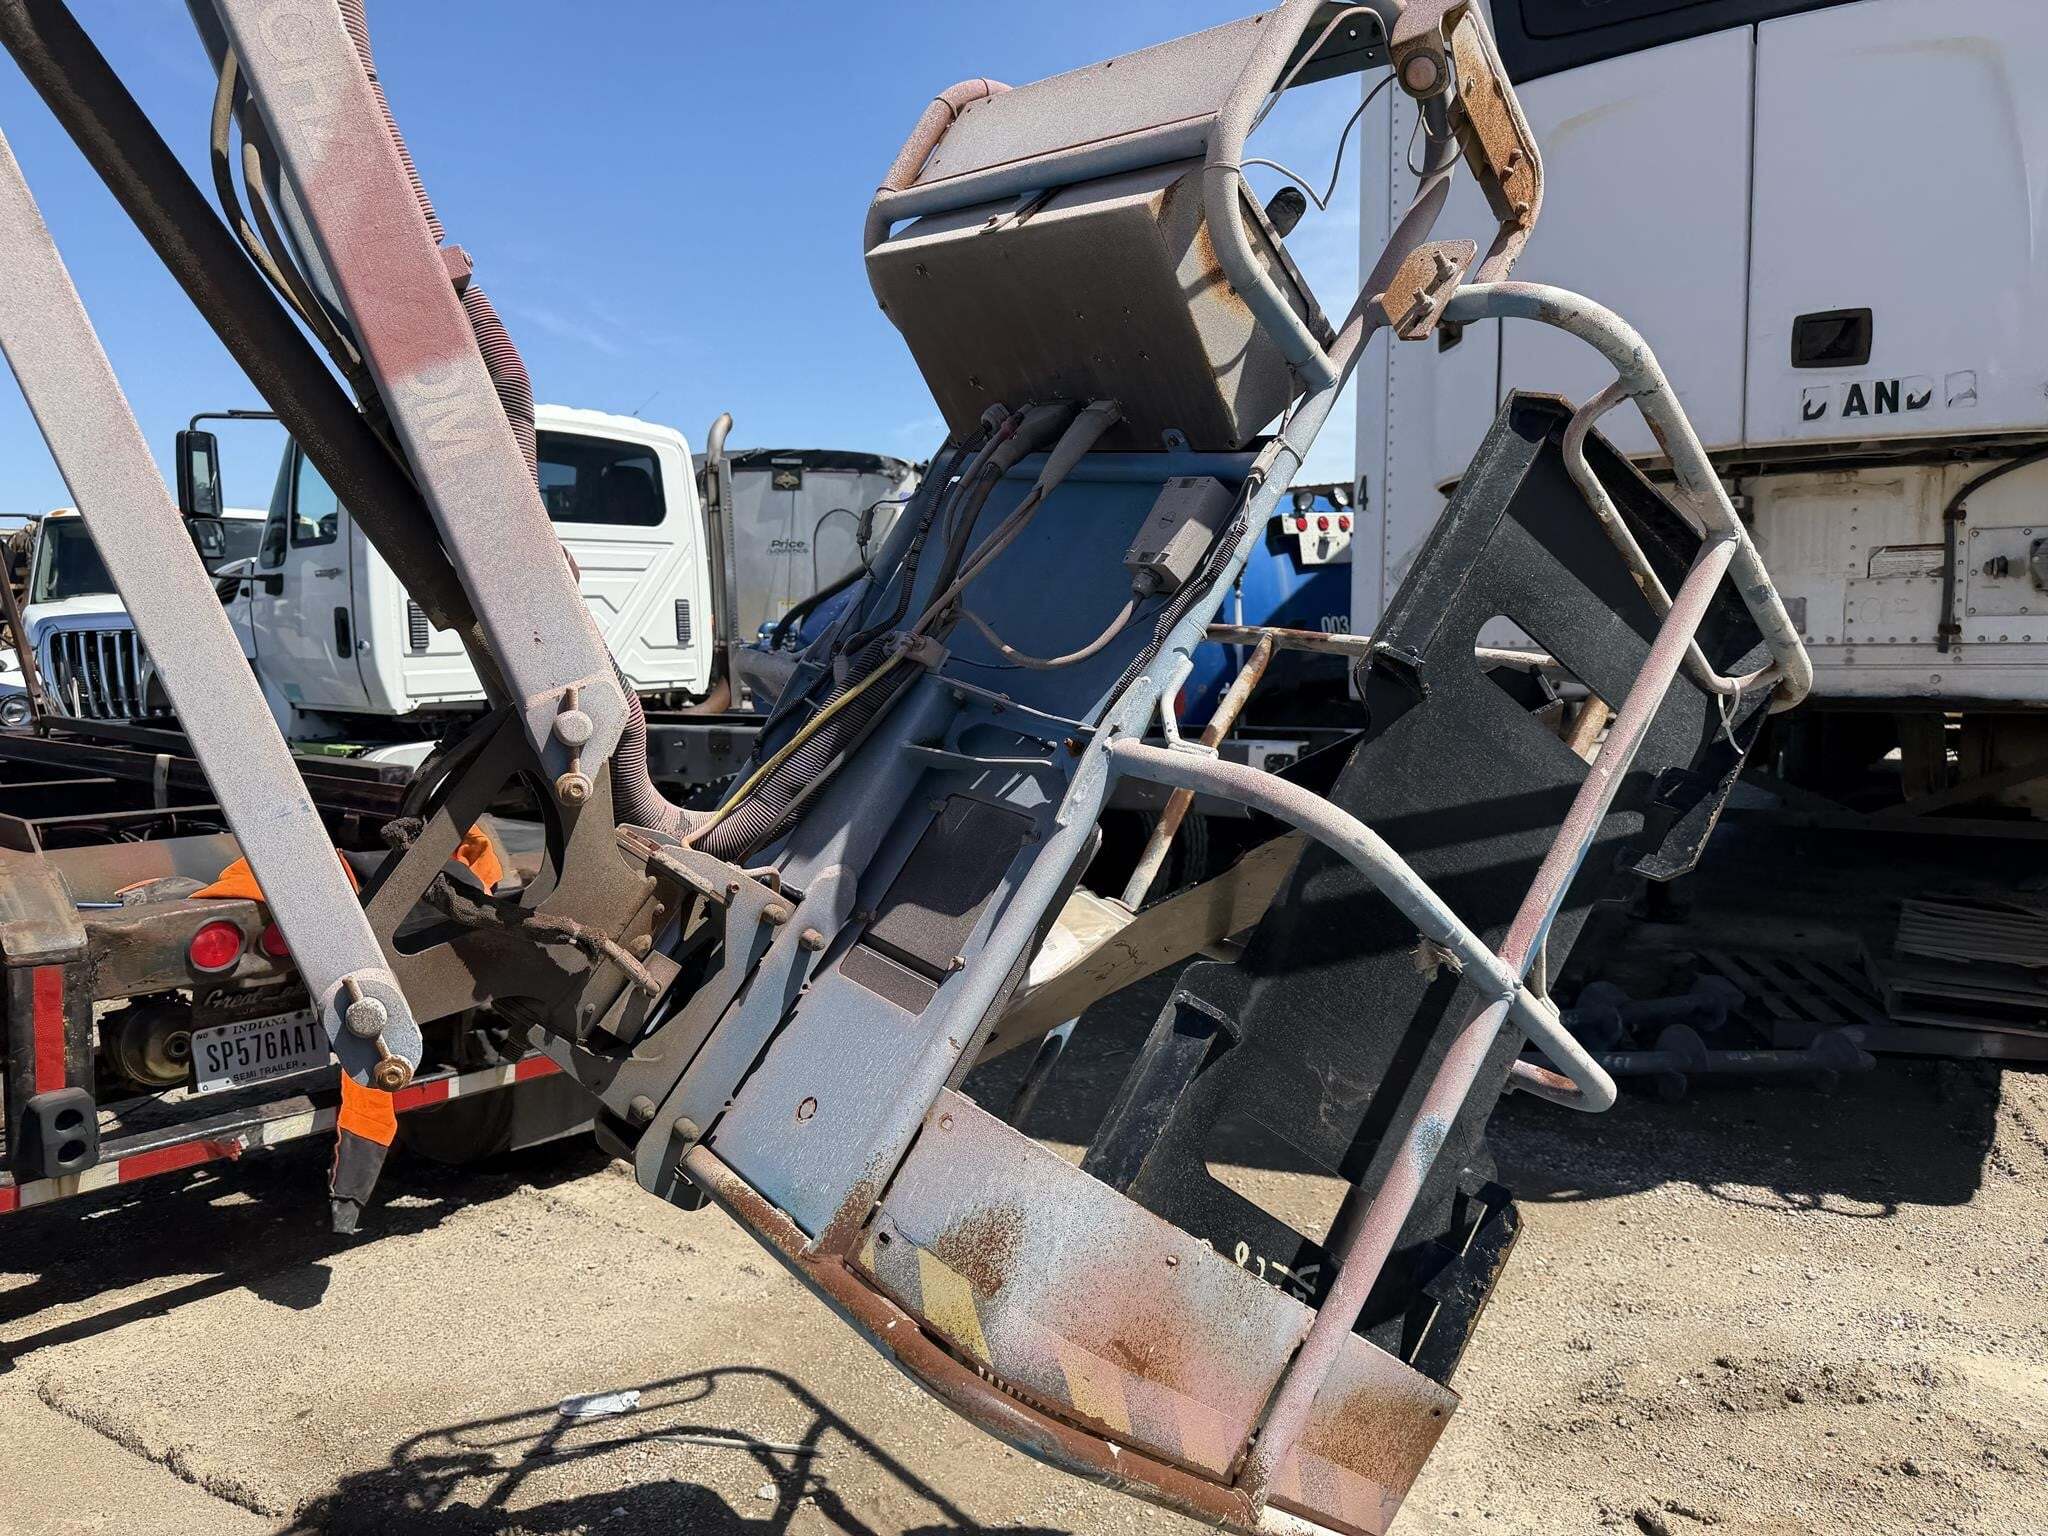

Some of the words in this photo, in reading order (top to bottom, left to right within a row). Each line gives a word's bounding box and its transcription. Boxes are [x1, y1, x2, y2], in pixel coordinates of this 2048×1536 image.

[1357, 475, 1369, 511] 4
[771, 538, 805, 548] Price
[1321, 616, 1350, 634] 003
[233, 1017, 288, 1035] INDIANA
[206, 1022, 318, 1073] SP576AAT
[233, 1070, 257, 1083] SEMI
[260, 1060, 299, 1077] TRAILER
